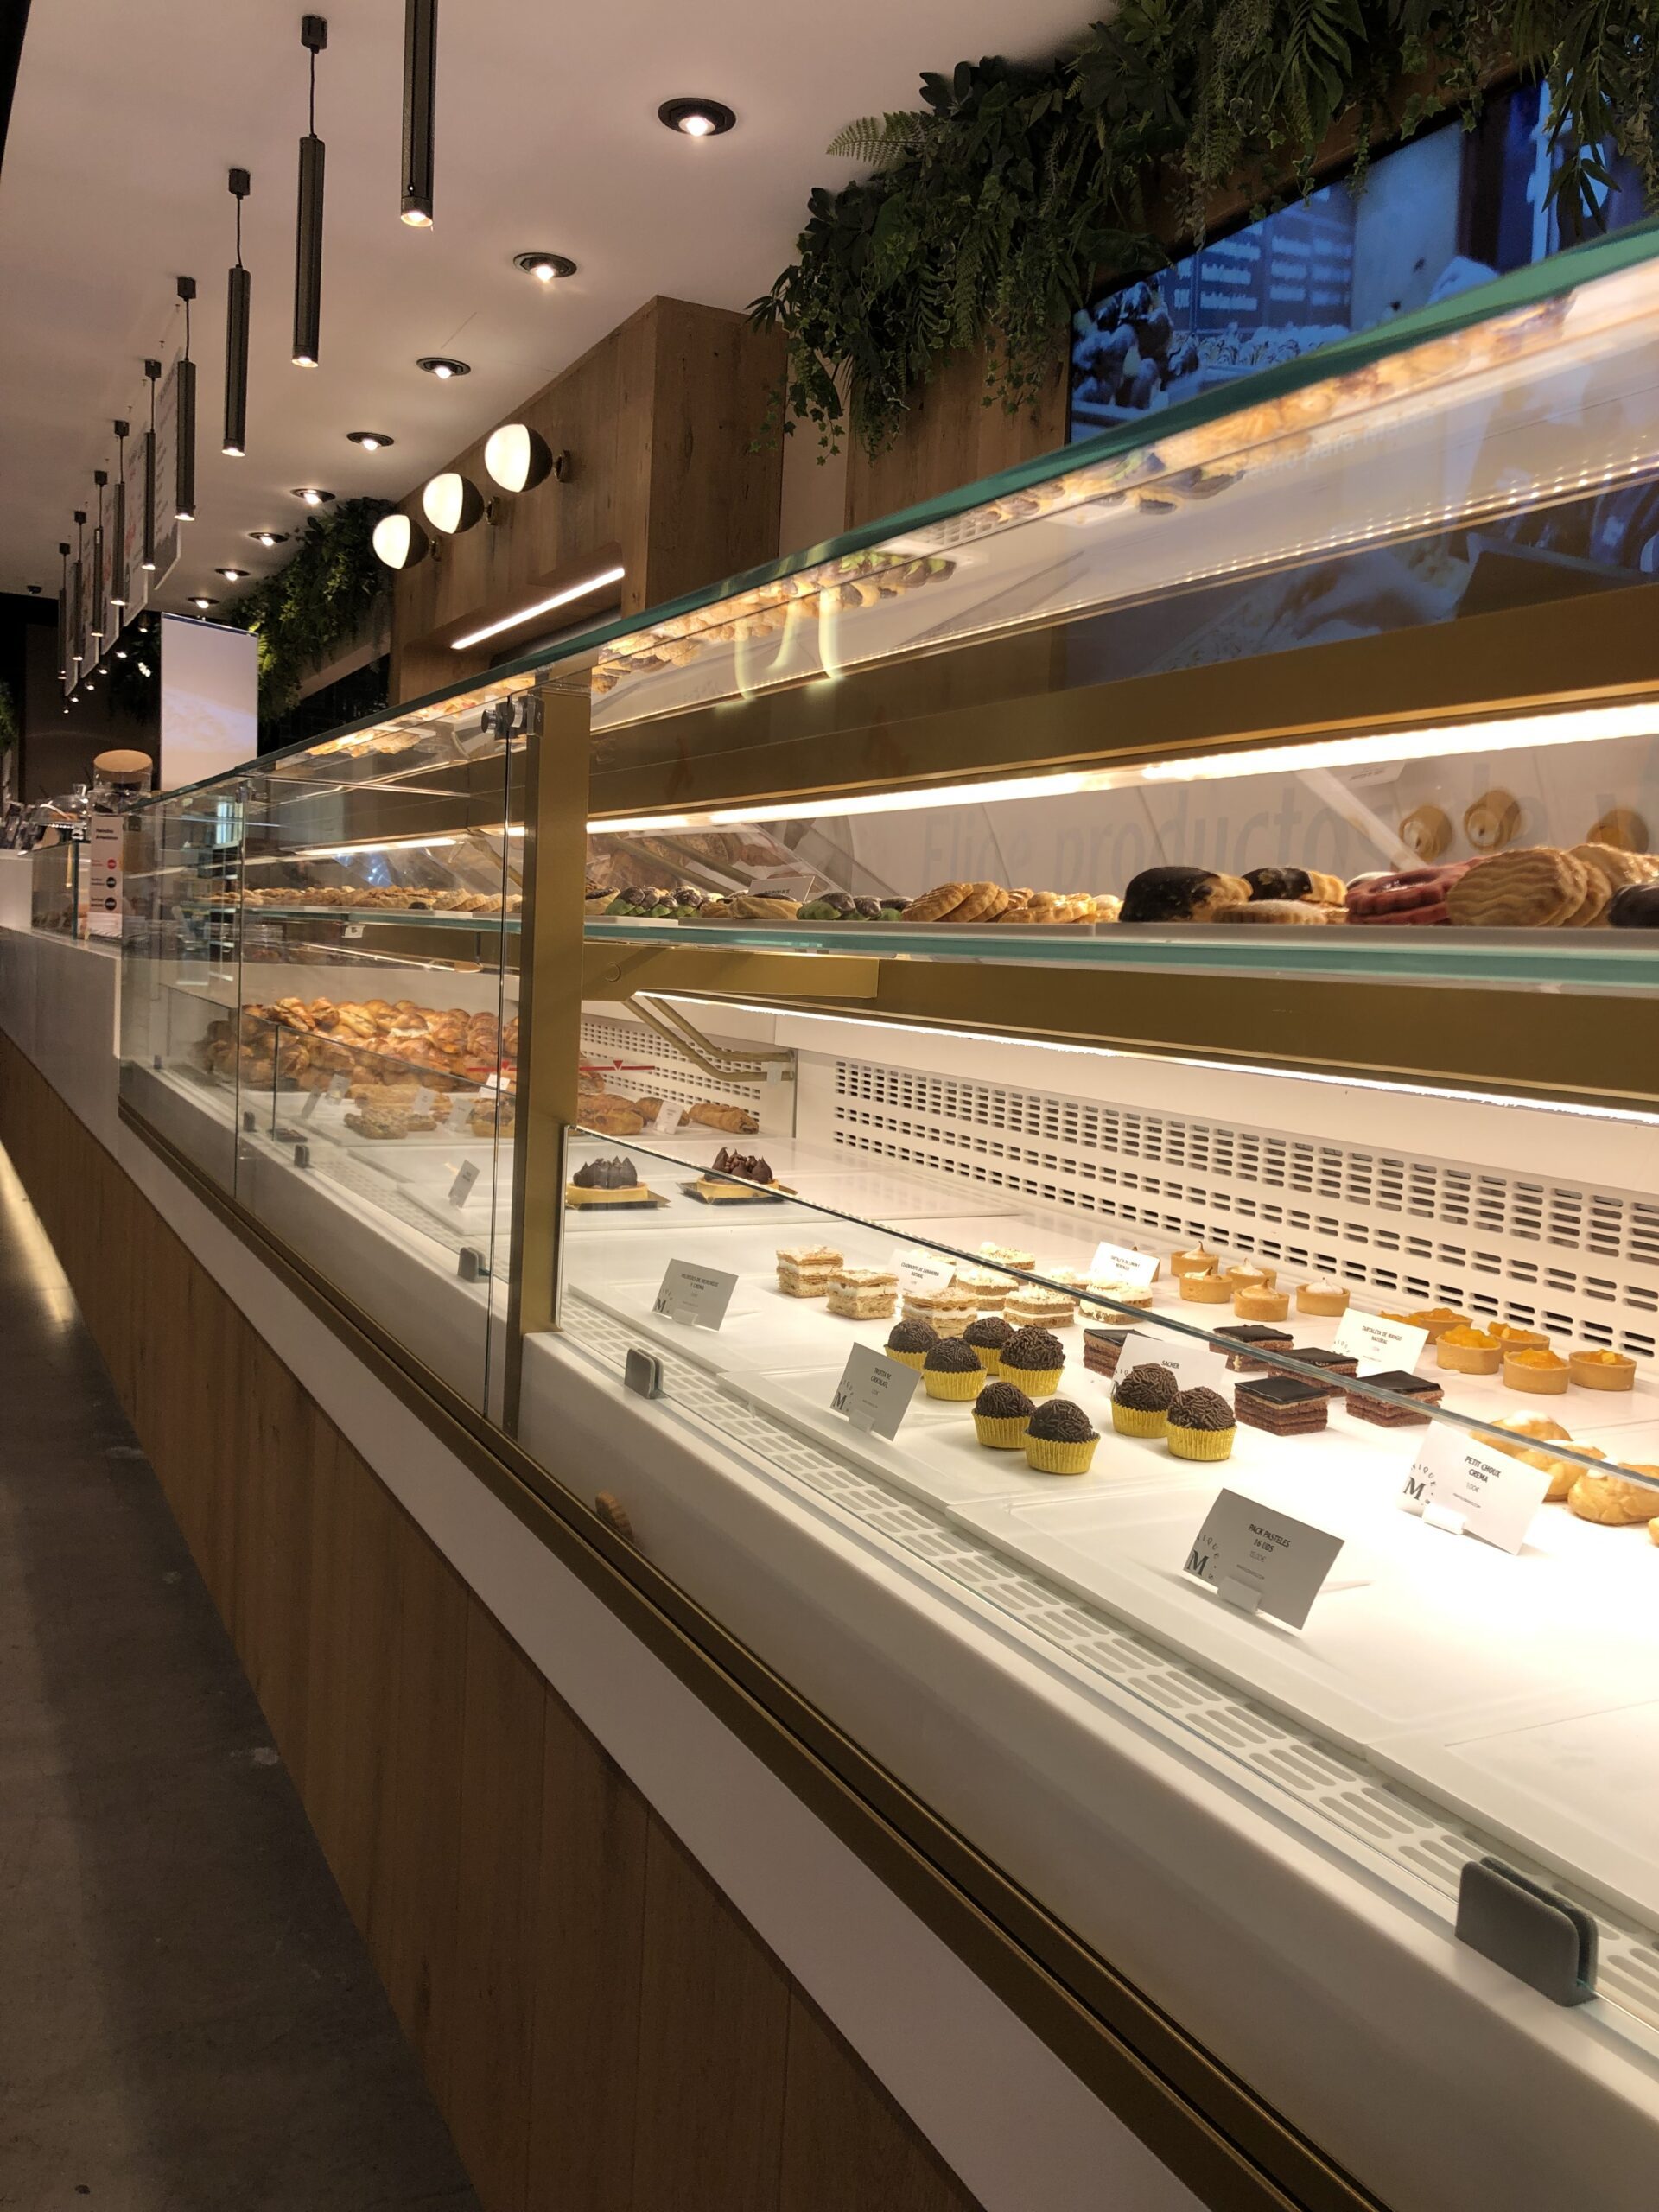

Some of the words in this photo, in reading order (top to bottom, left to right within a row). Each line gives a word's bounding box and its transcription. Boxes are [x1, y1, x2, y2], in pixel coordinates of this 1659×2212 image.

[1160, 1360, 1180, 1370] SACHER
[870, 1375, 889, 1389] CHOCOLATE
[833, 1391, 847, 1411] M
[1465, 1455, 1482, 1468] PETIT
[1480, 1463, 1502, 1478] CHOUX
[1468, 1468, 1489, 1484] CREMA
[1402, 1476, 1427, 1501] M
[1248, 1523, 1264, 1536] PACK
[1263, 1529, 1292, 1548] PASTELES
[1253, 1538, 1262, 1548] 16
[1261, 1541, 1275, 1554] UDS
[1186, 1549, 1210, 1577] M
